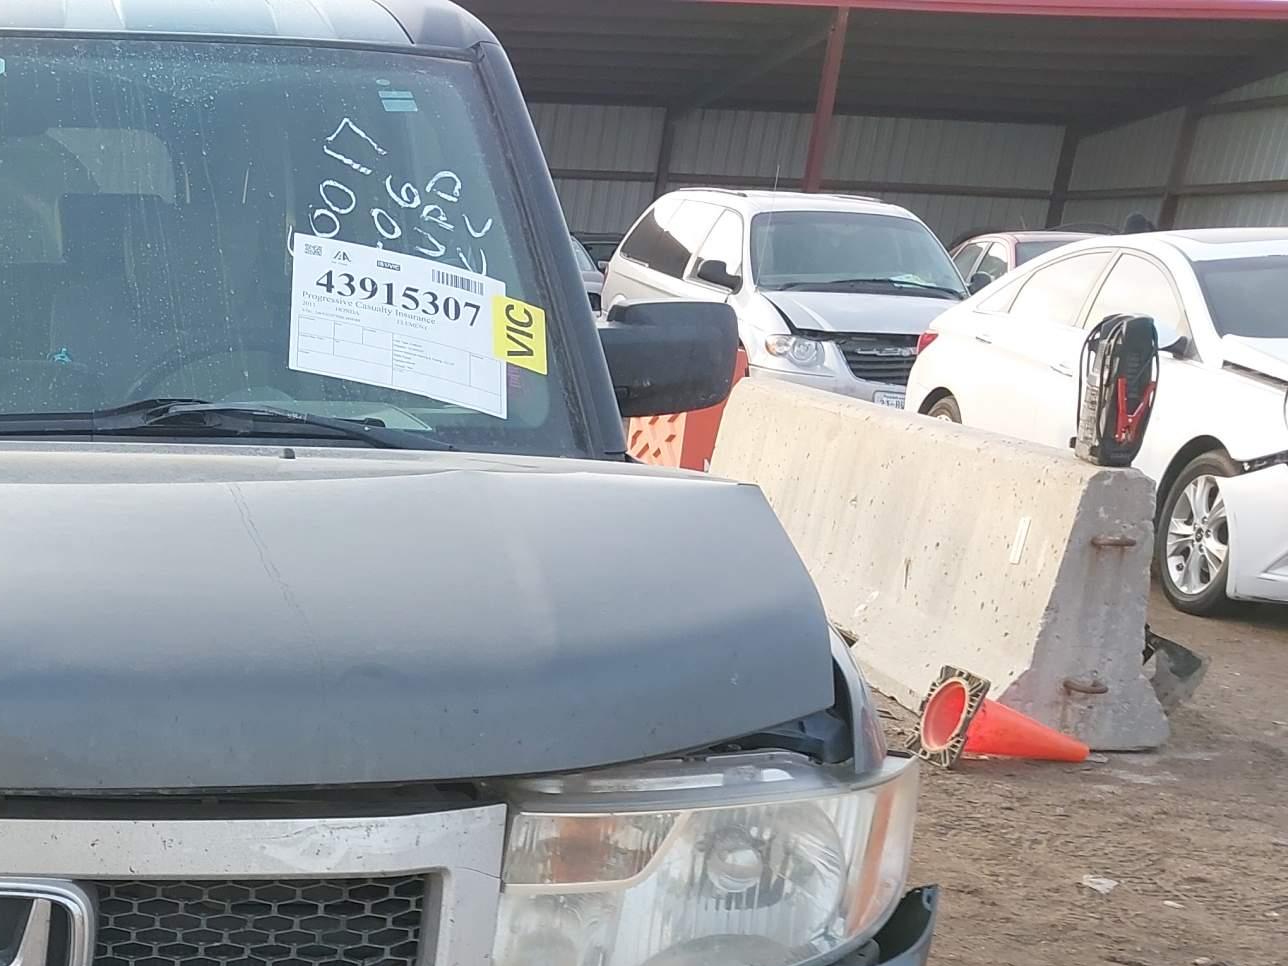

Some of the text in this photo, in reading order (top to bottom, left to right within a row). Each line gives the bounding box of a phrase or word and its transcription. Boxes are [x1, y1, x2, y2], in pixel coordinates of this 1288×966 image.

[302, 290, 354, 307] Progressive
[355, 300, 393, 317] Casualty
[395, 308, 436, 325] Insurance
[315, 269, 481, 327] 43915307
[505, 304, 534, 356] VIC
